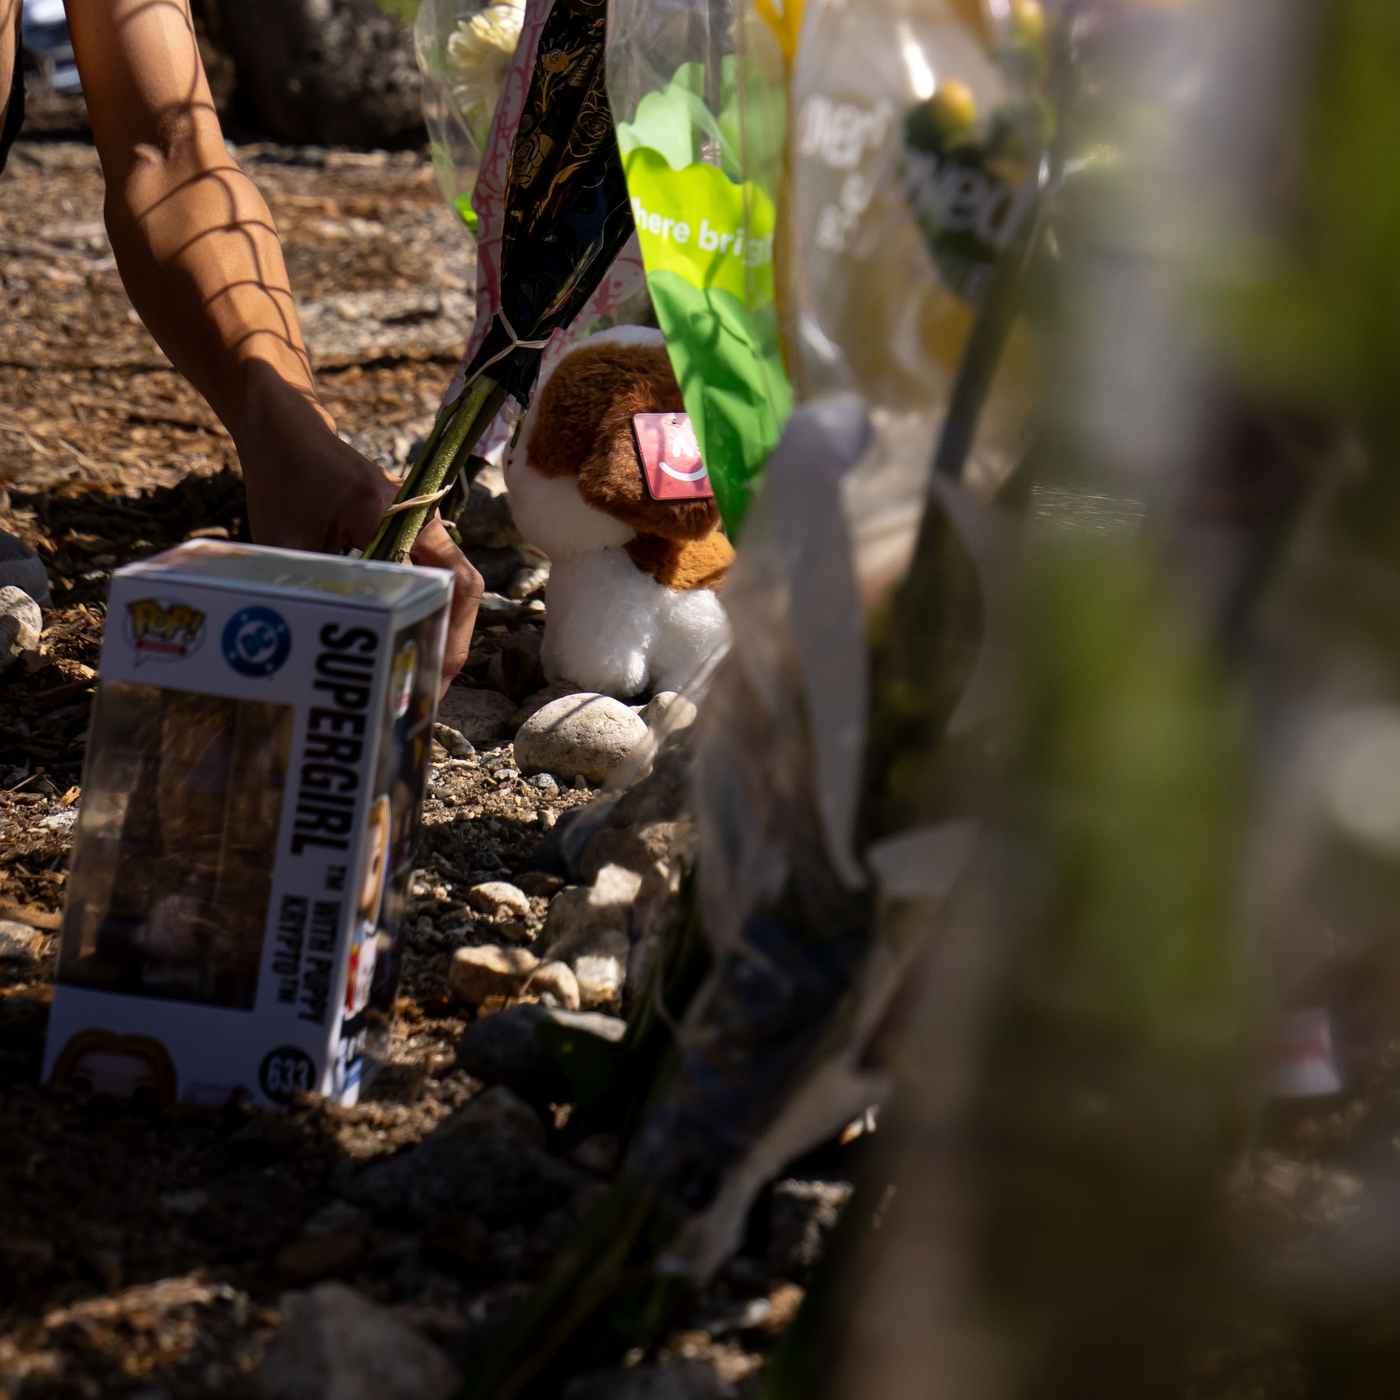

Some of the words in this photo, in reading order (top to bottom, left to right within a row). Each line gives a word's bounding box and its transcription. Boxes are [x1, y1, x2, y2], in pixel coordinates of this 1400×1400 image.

[631, 197, 691, 244] here
[240, 625, 276, 657] DC
[290, 623, 379, 856] SUPERGIRL
[308, 900, 342, 953] WITH
